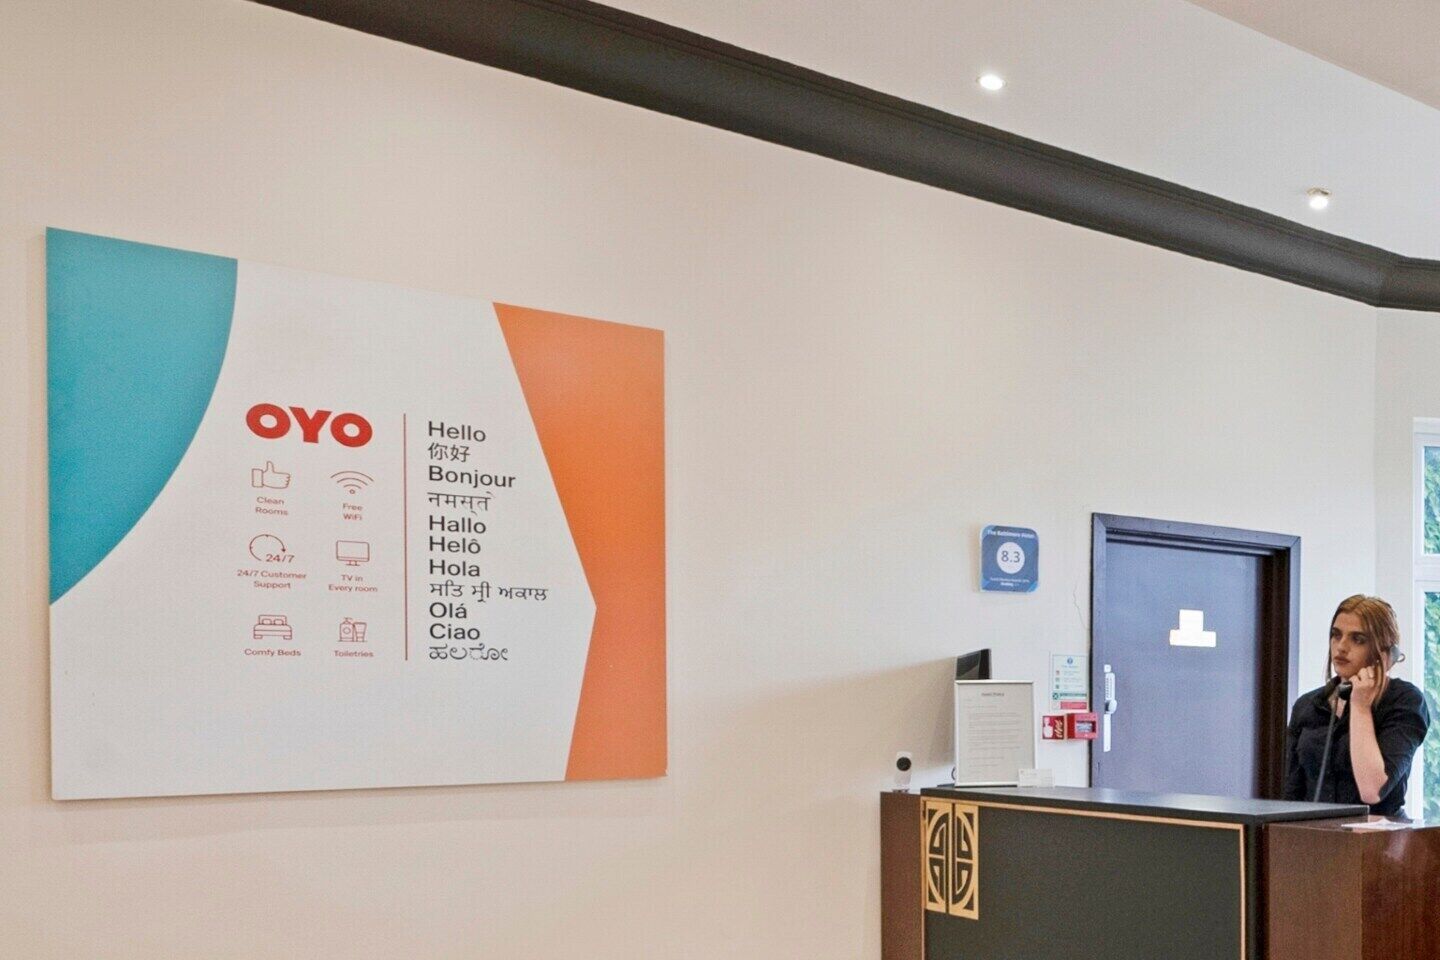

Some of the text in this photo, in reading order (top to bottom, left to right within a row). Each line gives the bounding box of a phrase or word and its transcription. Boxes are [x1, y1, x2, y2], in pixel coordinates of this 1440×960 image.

[246, 403, 373, 448] OYO
[428, 420, 487, 442] Hello
[427, 442, 471, 463] 你好
[428, 465, 516, 488] Bonjour
[256, 496, 285, 505] Clean
[343, 502, 363, 511] Free
[255, 506, 288, 516] Rooms
[429, 515, 487, 534] Hallo
[429, 535, 481, 555] Helô
[265, 553, 295, 563] 24/7
[1001, 550, 1021, 563] 8.3
[429, 558, 480, 577] Hola
[237, 569, 307, 580] 24/7 Customer
[341, 574, 355, 582] TV
[253, 580, 291, 590] Support
[328, 584, 378, 593] Every room
[429, 602, 467, 619] Olá
[429, 623, 481, 640] Ciao
[244, 648, 302, 657] Comfy Beds
[334, 649, 374, 658] Toiletries
